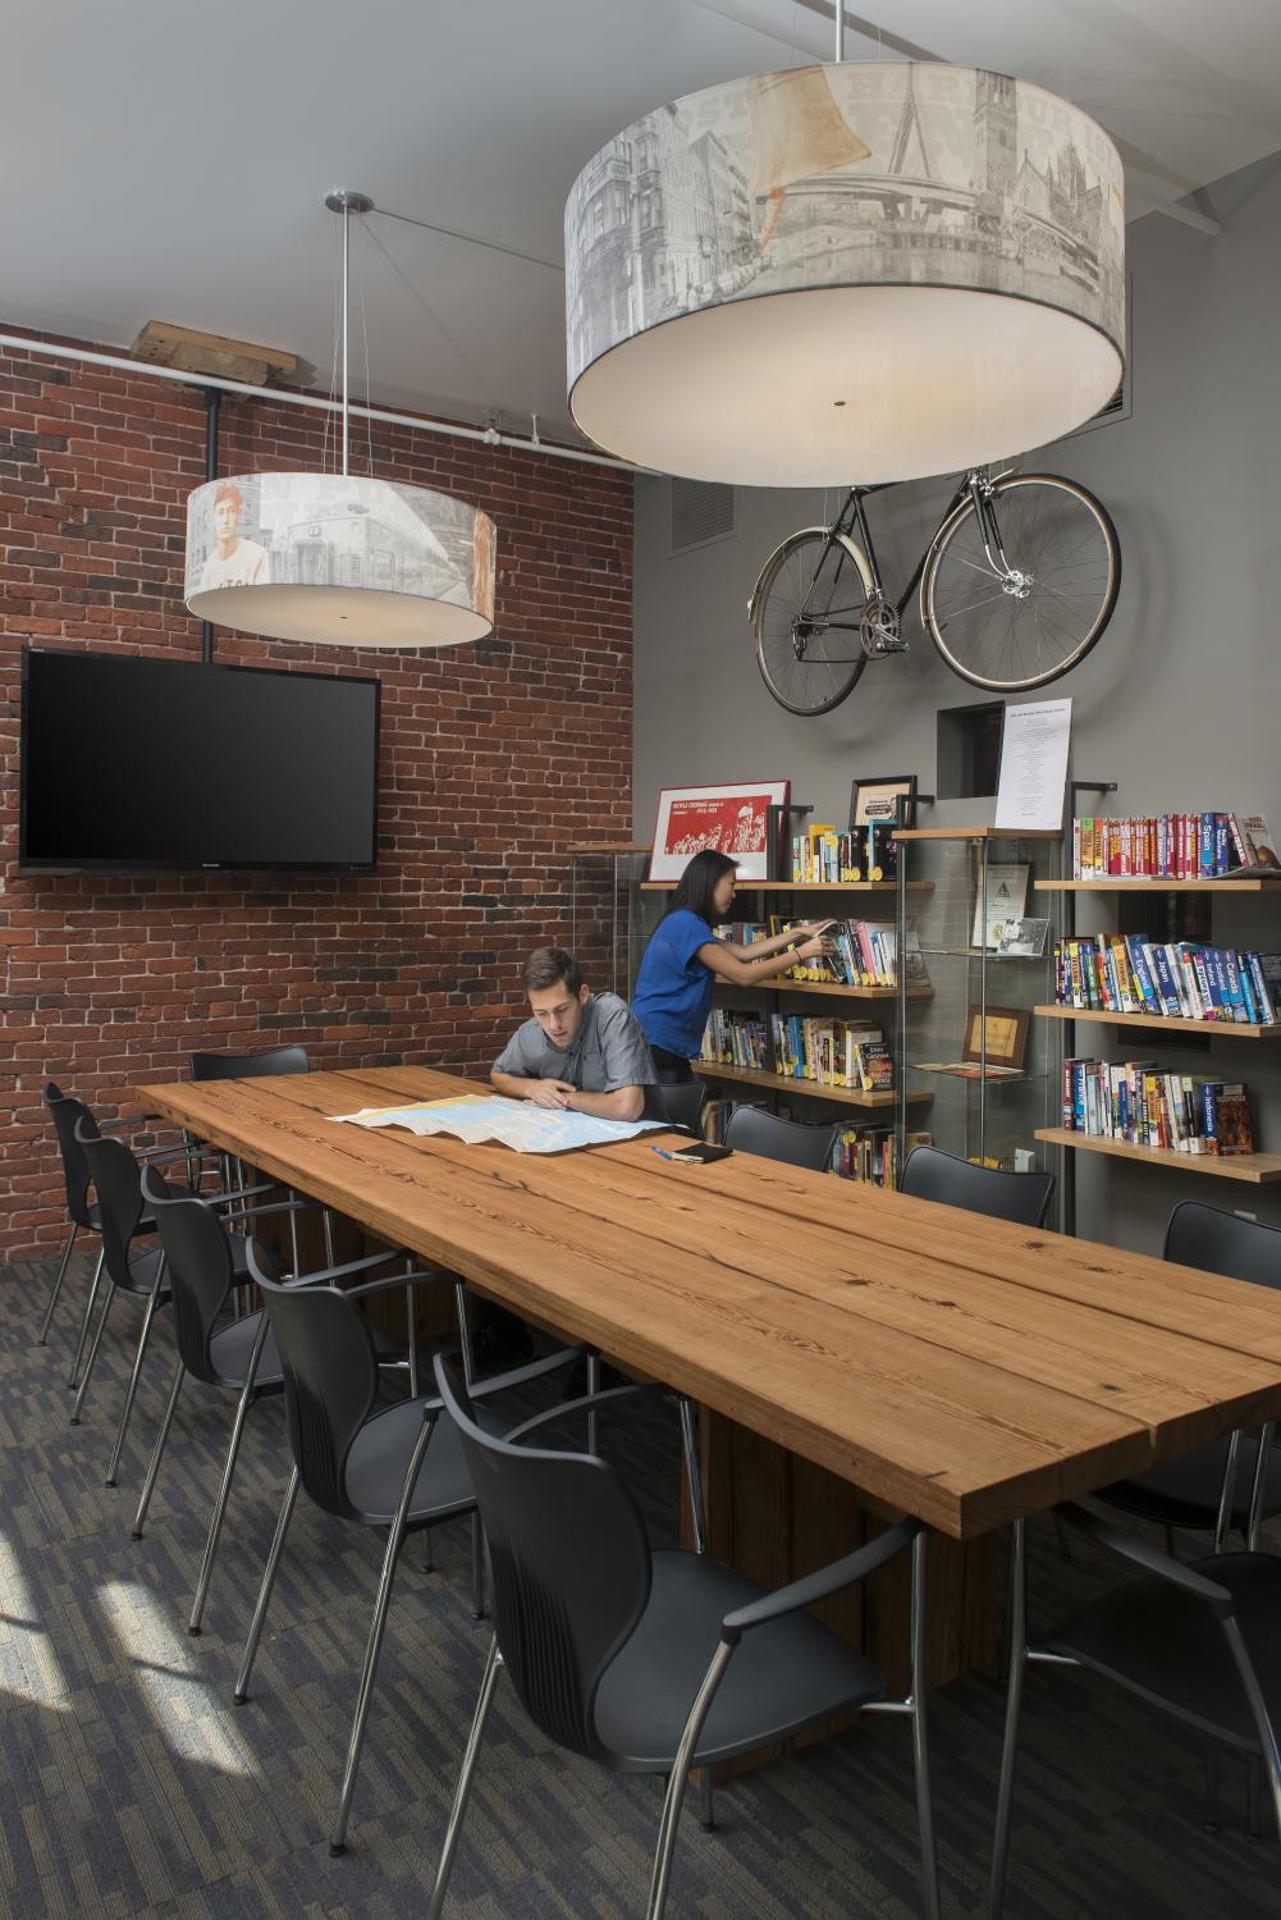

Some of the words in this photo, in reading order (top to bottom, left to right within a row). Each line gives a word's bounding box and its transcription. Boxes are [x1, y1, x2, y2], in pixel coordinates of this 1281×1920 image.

[1202, 825, 1212, 851] Spain
[1135, 959, 1149, 990] England
[1159, 961, 1170, 983] Japan
[1227, 963, 1239, 995] Canada
[1205, 1097, 1213, 1132] Indonesia
